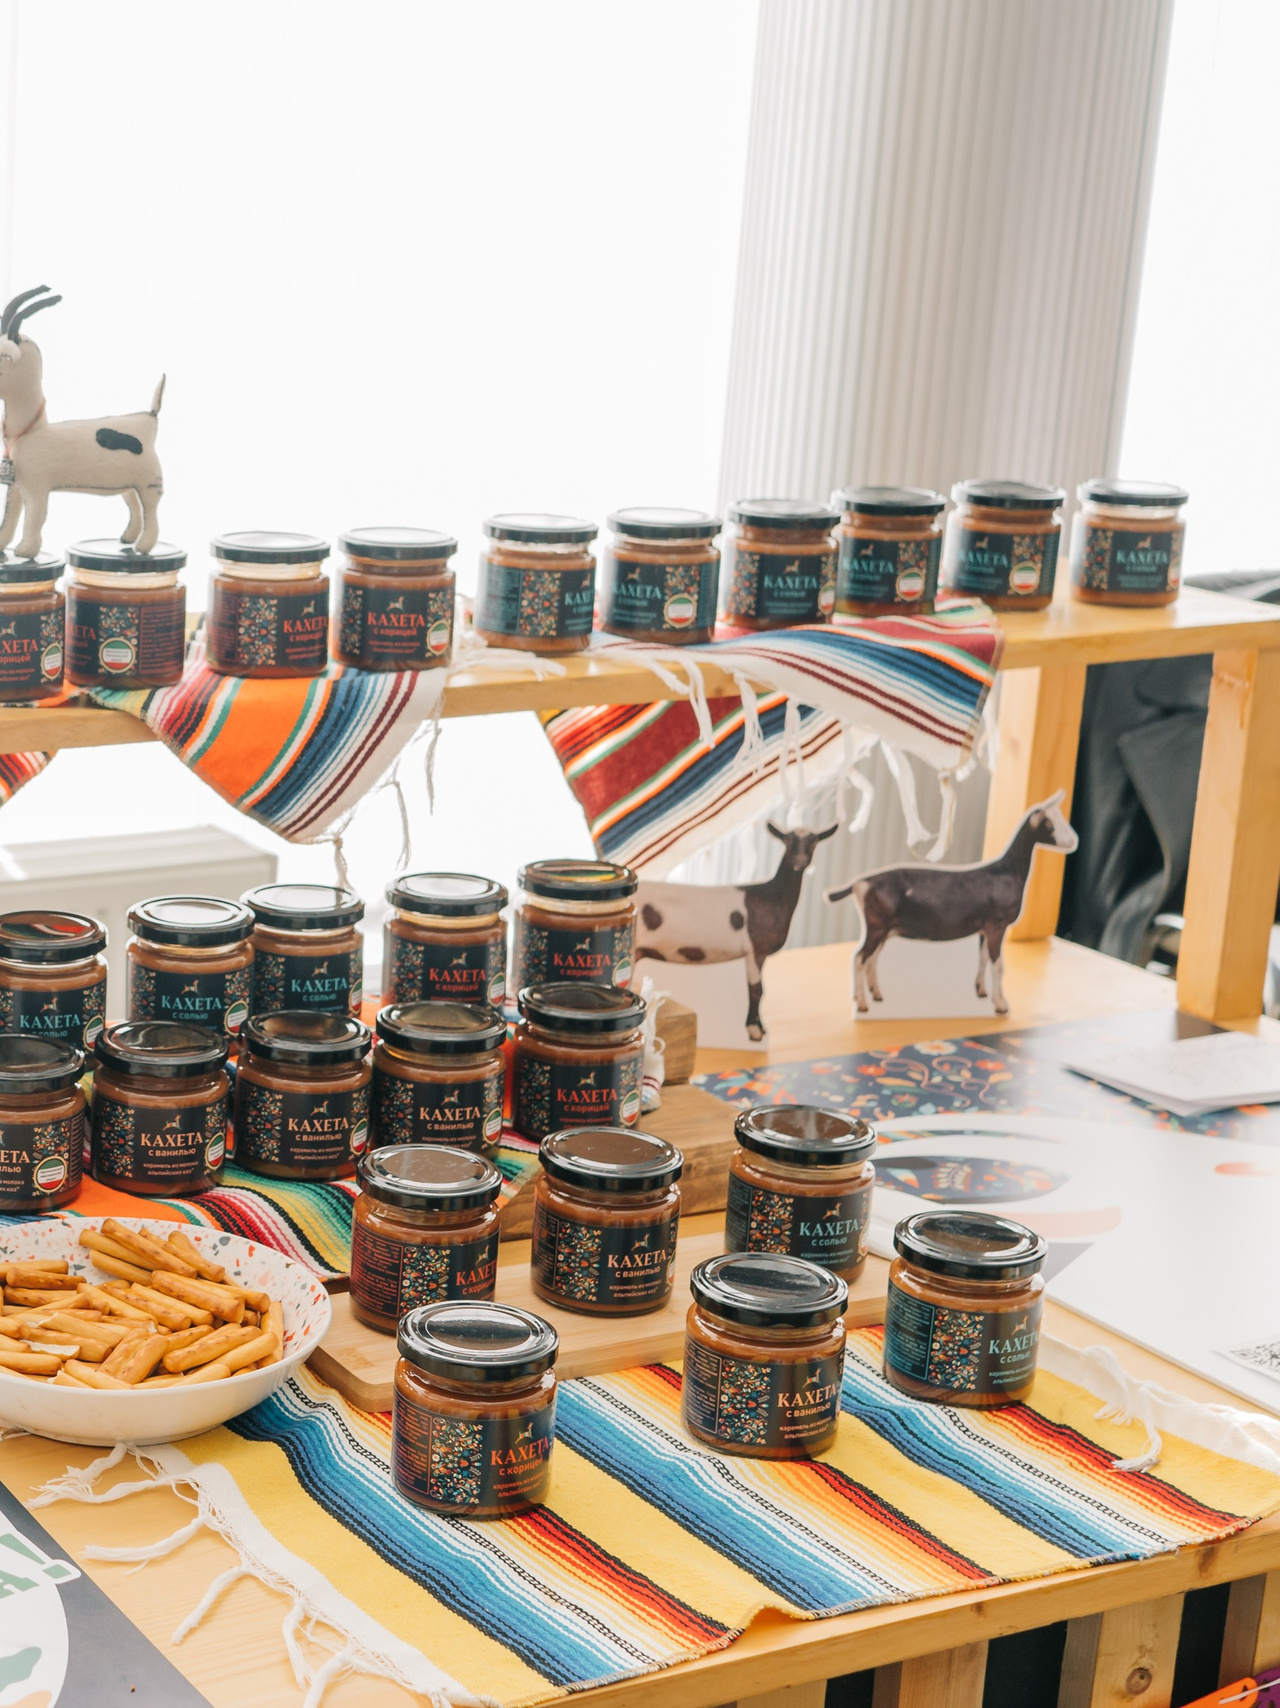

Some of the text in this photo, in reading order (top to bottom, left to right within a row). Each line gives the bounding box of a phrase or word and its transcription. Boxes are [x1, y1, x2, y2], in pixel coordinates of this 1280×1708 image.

[367, 611, 426, 628] КАХЕТА
[553, 952, 612, 969] КАХЕТА
[428, 967, 487, 983] КАХЕТА
[291, 977, 349, 994] КАХЕТА
[435, 983, 480, 994] с корицей
[161, 995, 222, 1012] КАХЕТА
[309, 993, 337, 1002] солью
[20, 1014, 81, 1029] КАХЕТА
[172, 1011, 209, 1020] с солью
[557, 1087, 618, 1103] КАХЕТА
[419, 1106, 481, 1121] КАХЕТА
[563, 1103, 610, 1115] с корицей
[288, 1117, 349, 1132] КАХЕТА
[433, 1122, 474, 1131] ванилью
[140, 1131, 204, 1148] КАХЕТА
[302, 1133, 342, 1142] ванилью
[148, 1148, 197, 1157] с ванилью
[799, 1218, 859, 1237] КАХЕТА
[811, 1238, 848, 1246] с солью
[607, 1249, 667, 1269] КАХЕТА
[456, 1260, 497, 1286] КАХЕТ
[615, 1266, 661, 1278] с ванилью
[462, 1287, 468, 1295] с
[1000, 1355, 1006, 1364] с
[777, 1383, 837, 1408] КАХЕТА
[786, 1401, 831, 1418] с ванилью
[490, 1436, 551, 1467] КАХЕТА
[499, 1467, 505, 1475] с
